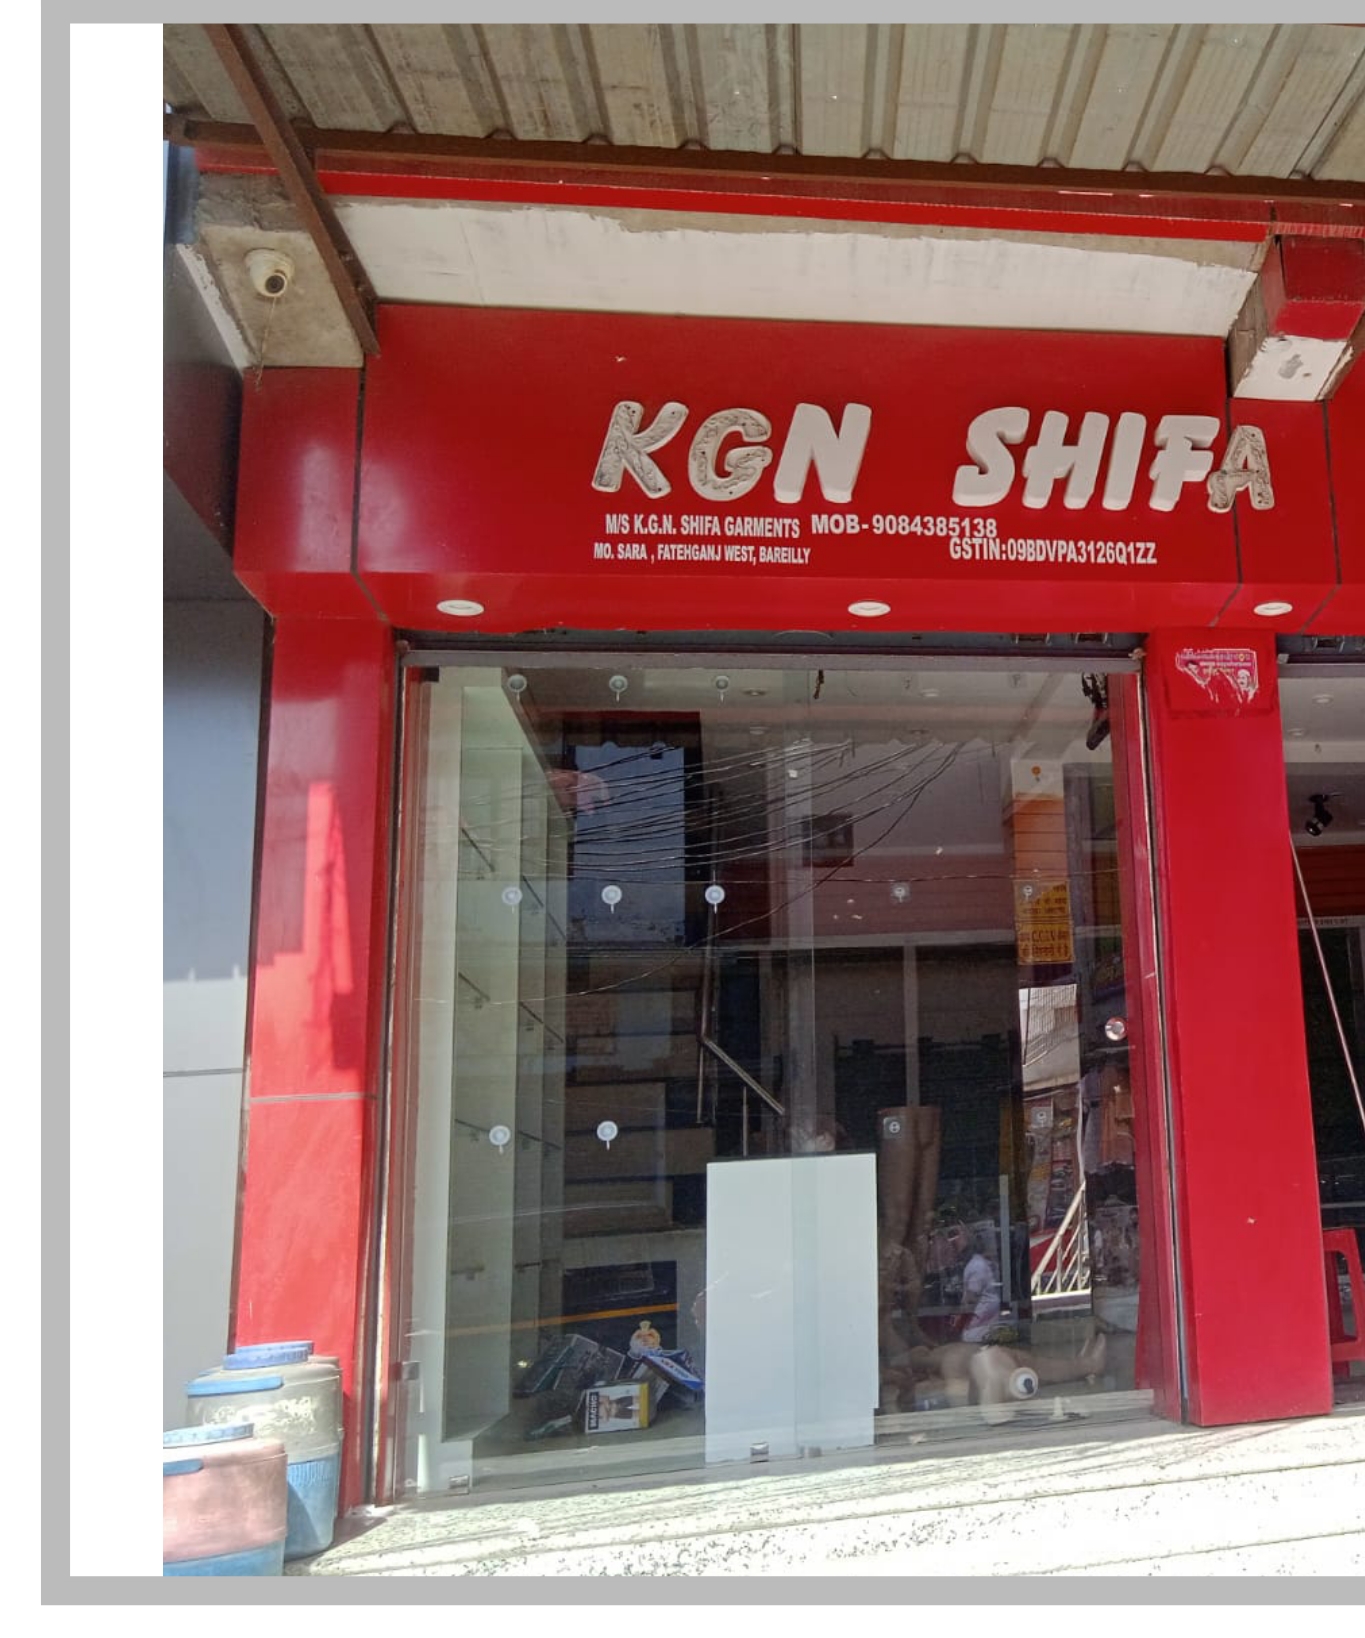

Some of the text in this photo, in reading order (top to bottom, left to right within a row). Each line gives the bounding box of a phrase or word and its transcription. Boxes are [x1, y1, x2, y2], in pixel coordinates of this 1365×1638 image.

[591, 401, 872, 504] KGN
[953, 406, 1275, 513] SHIFA
[605, 513, 800, 539] M/S K.G.N. SHIFA GARMENTS
[872, 515, 997, 538] 9084385138
[593, 542, 614, 560] MO.
[657, 544, 721, 561] FATEHGANJ
[724, 545, 756, 565] WEST,
[759, 546, 811, 565] BAREILLY
